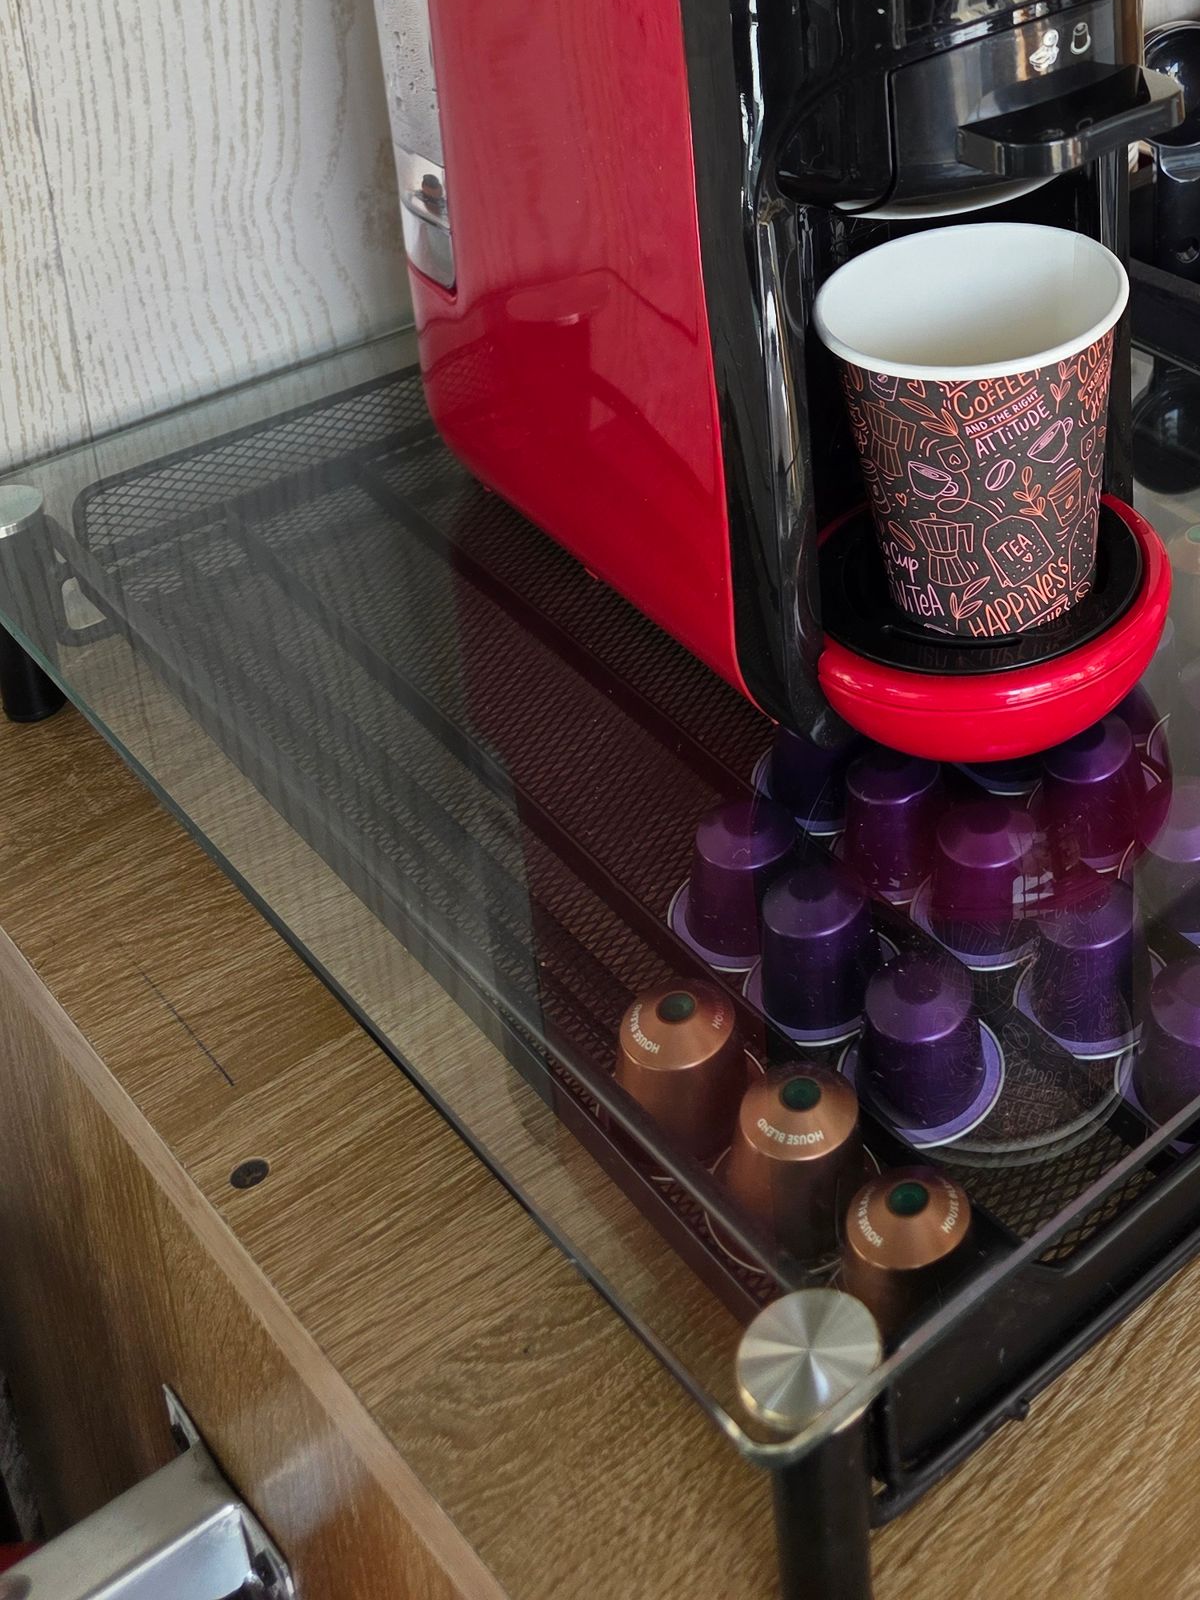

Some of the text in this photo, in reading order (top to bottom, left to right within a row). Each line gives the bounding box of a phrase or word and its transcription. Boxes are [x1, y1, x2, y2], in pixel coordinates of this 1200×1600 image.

[953, 372, 1033, 420] COFFEE
[965, 389, 1040, 436] AND THE RIGHT
[996, 533, 1033, 562] TEA
[632, 1029, 661, 1055] HOUSE
[757, 1118, 825, 1146] HOUSE BLEND
[858, 1216, 884, 1248] HOUSE
